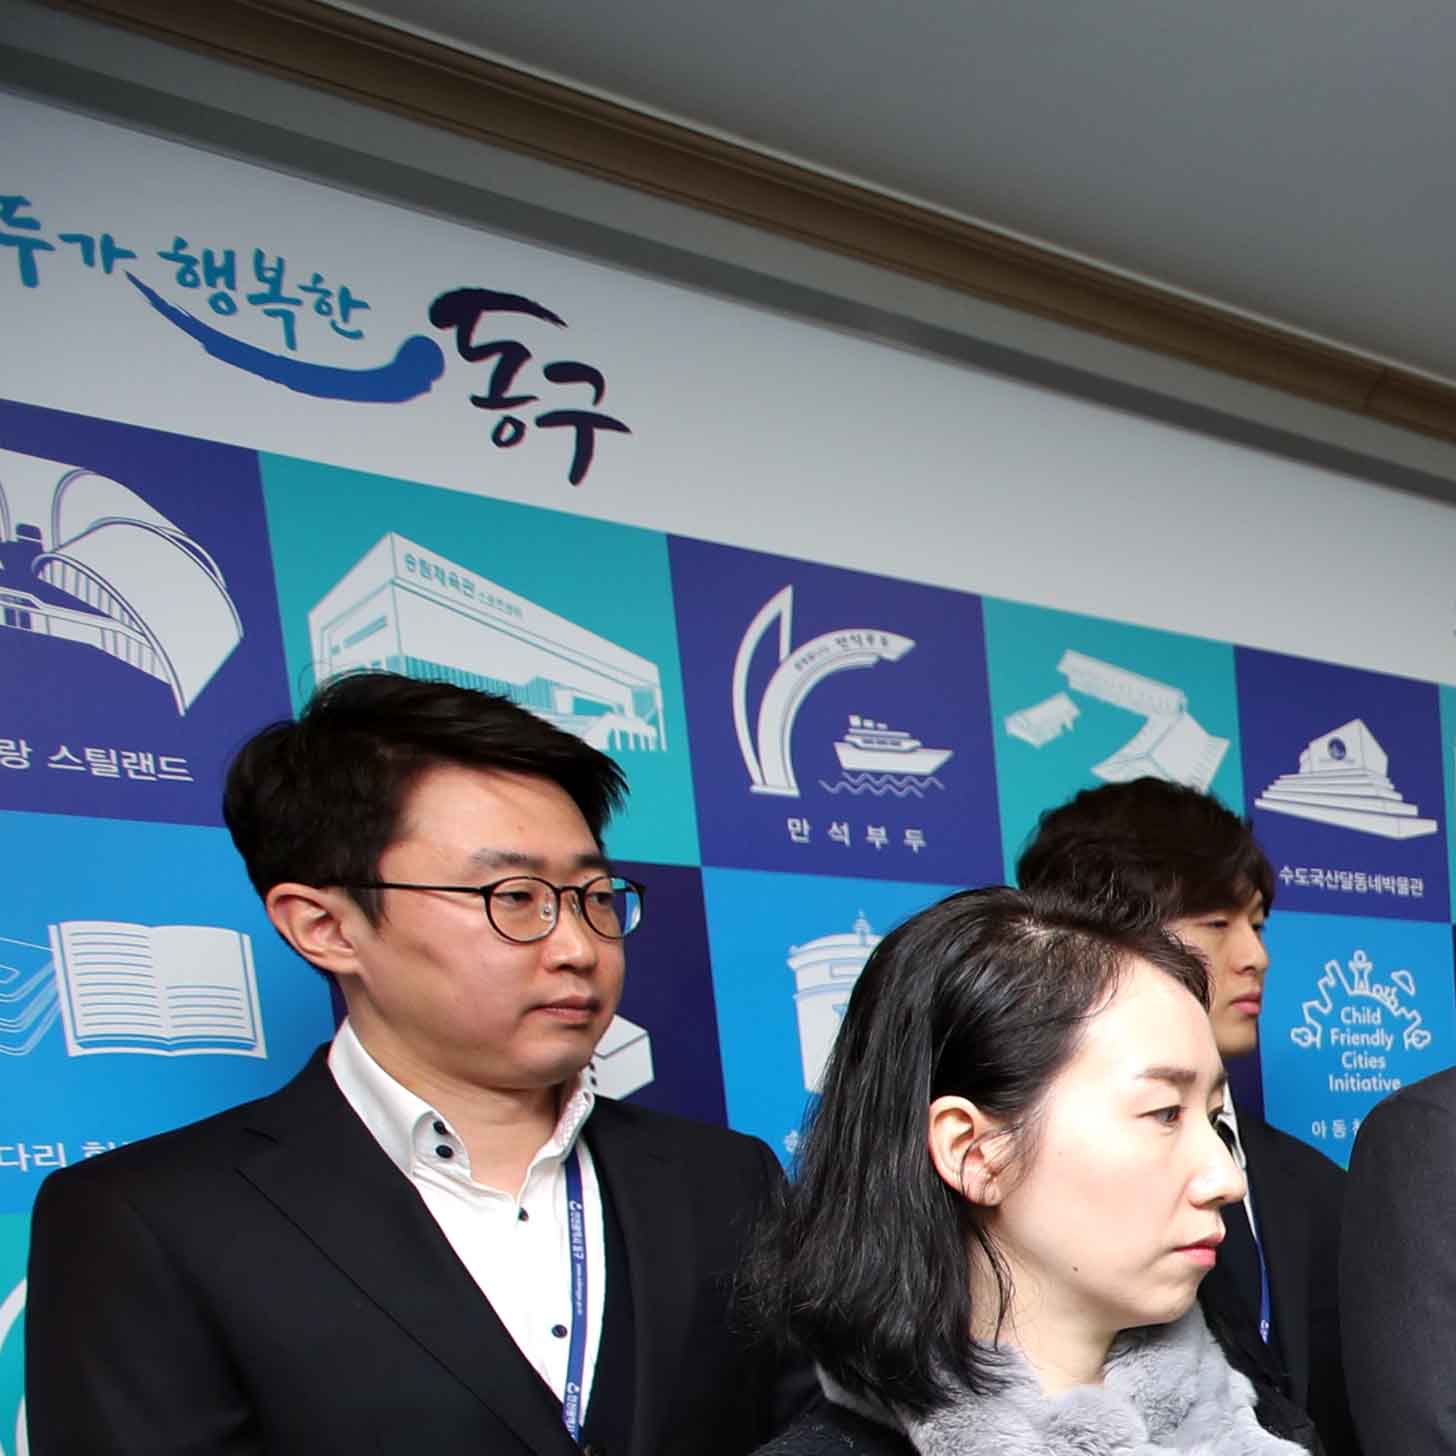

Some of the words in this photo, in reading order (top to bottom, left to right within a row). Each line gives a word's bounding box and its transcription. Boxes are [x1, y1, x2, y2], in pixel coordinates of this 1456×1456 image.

[158, 236, 371, 350] 행복한
[429, 287, 631, 487] 동구
[47, 745, 195, 782] 스틸랜드
[1279, 865, 1425, 897] 수도국산달동네박물관
[1340, 1005, 1381, 1025] Child
[1330, 1026, 1393, 1050] Friendly
[1341, 1050, 1386, 1069] Cities
[1328, 1073, 1401, 1093] Initiative
